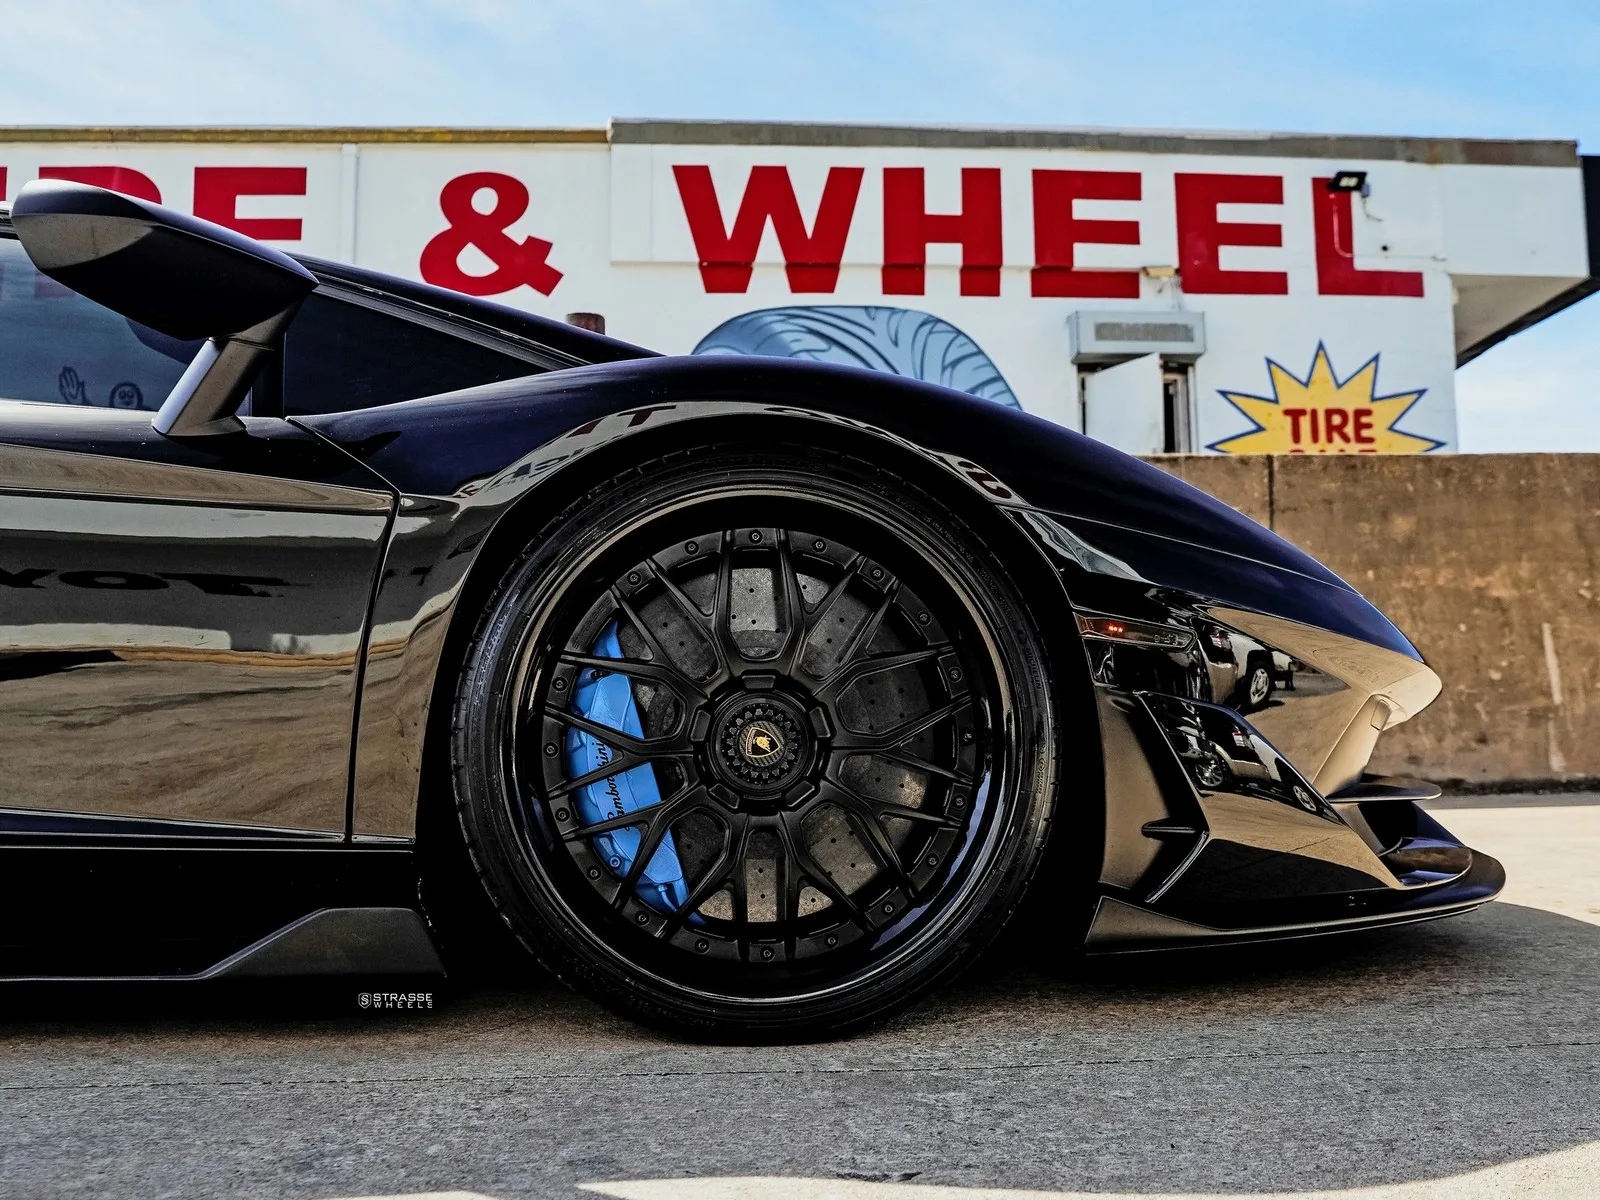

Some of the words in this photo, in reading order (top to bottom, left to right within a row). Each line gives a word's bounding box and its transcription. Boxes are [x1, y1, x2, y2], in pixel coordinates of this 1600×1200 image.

[420, 171, 564, 297] &
[672, 165, 1424, 298] WHEEL
[1283, 408, 1376, 444] TIRE
